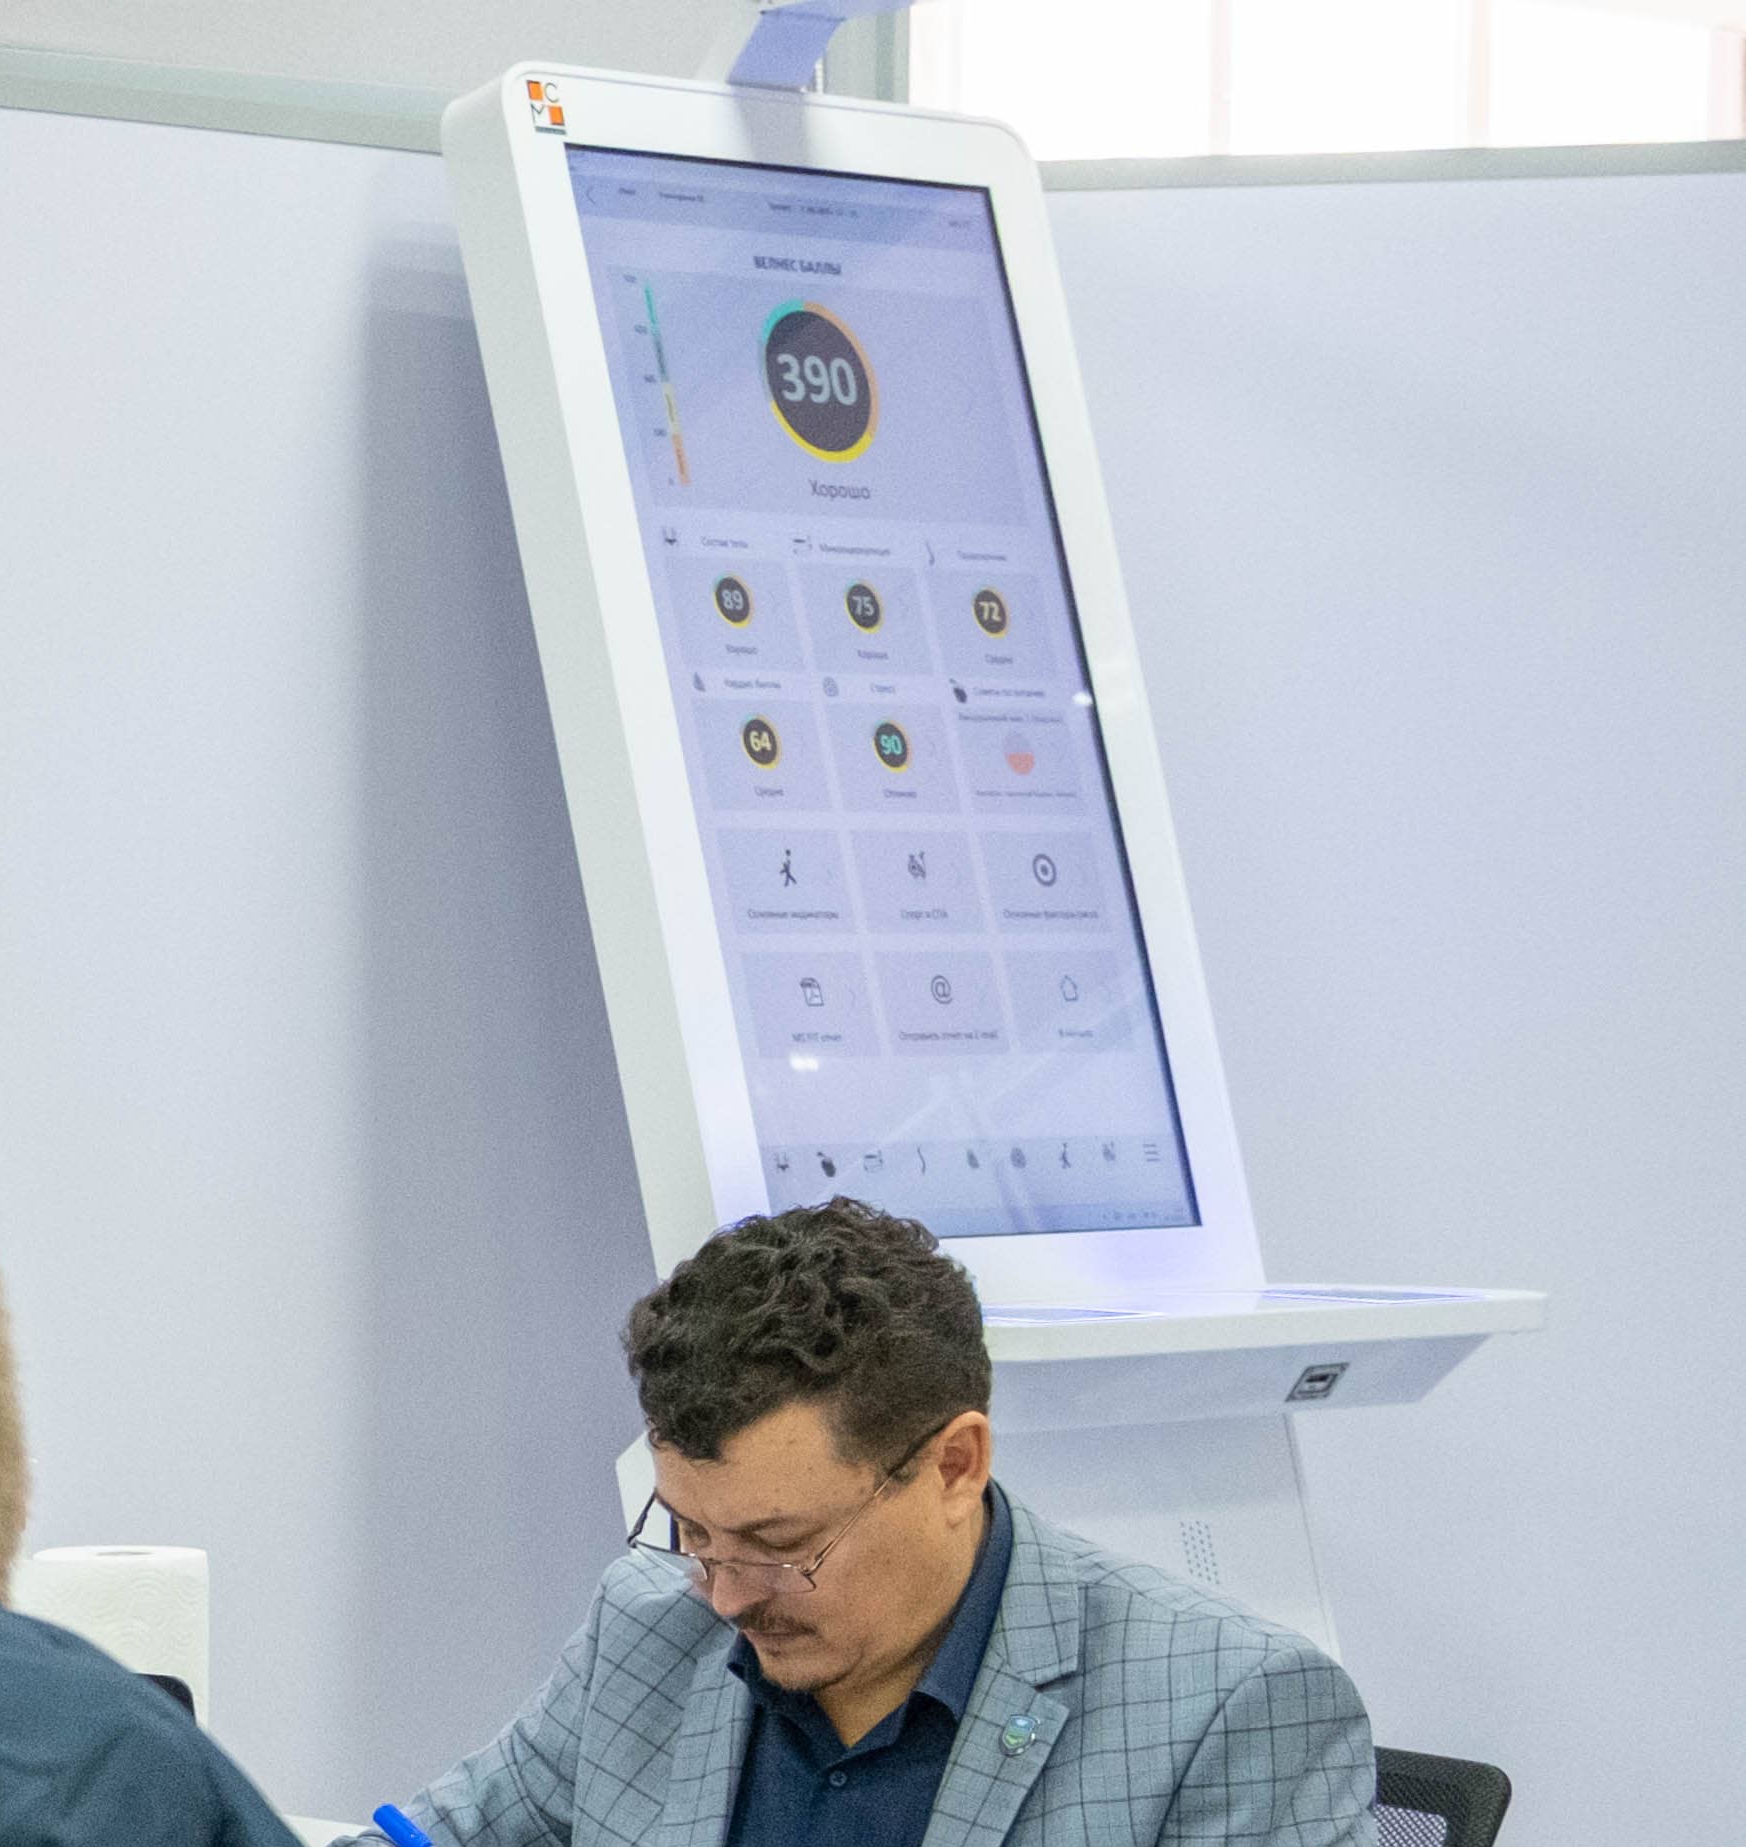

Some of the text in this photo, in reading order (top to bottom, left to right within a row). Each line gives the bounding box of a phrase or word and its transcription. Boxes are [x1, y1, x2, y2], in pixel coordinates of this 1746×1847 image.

[753, 255, 799, 273] ВЕЛНЕС
[776, 353, 857, 405] 390
[809, 480, 871, 500] Хорошо
[721, 589, 744, 610] 89
[852, 596, 875, 616] 75
[979, 601, 1002, 622] 72
[749, 730, 772, 752] 64
[879, 734, 904, 756] 90
